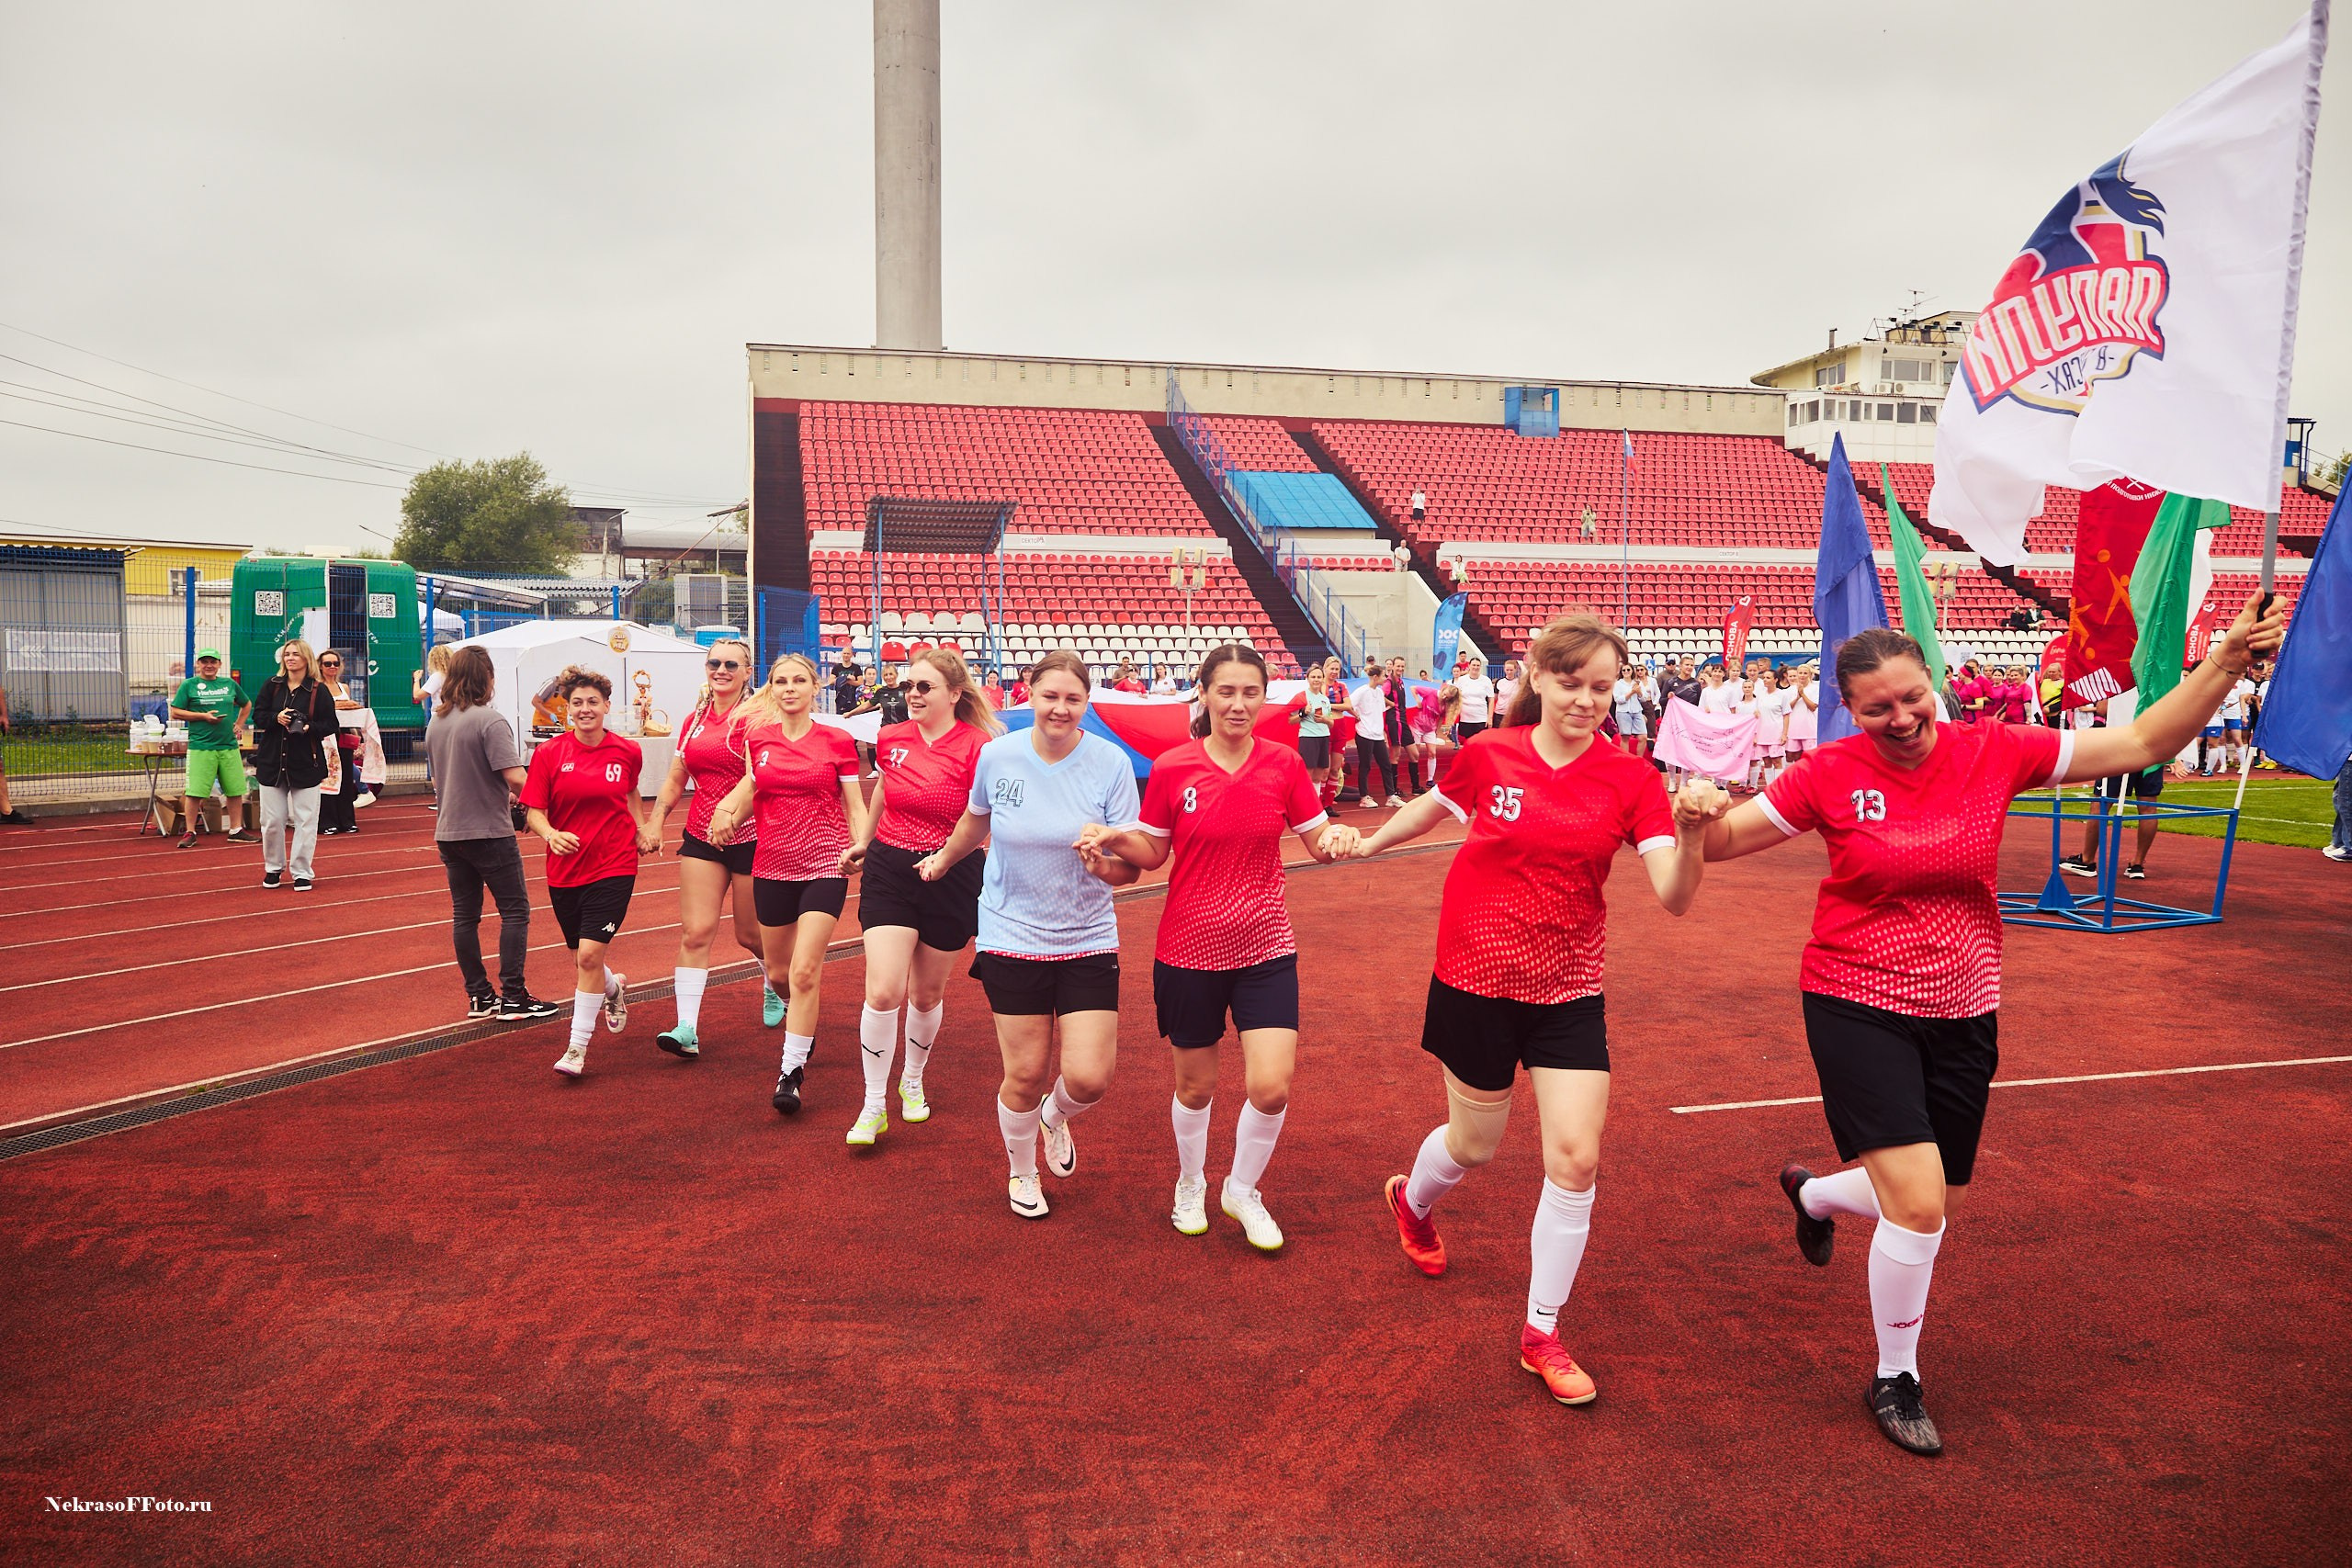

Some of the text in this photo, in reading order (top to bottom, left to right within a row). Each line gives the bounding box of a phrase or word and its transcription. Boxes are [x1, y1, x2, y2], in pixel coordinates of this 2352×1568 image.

[2187, 624, 2200, 662] ОСНОВА
[605, 762, 623, 783] 69
[994, 778, 1024, 807] 24
[1182, 785, 1197, 814] 8
[1489, 784, 1524, 822] 35
[1850, 789, 1887, 823] 13
